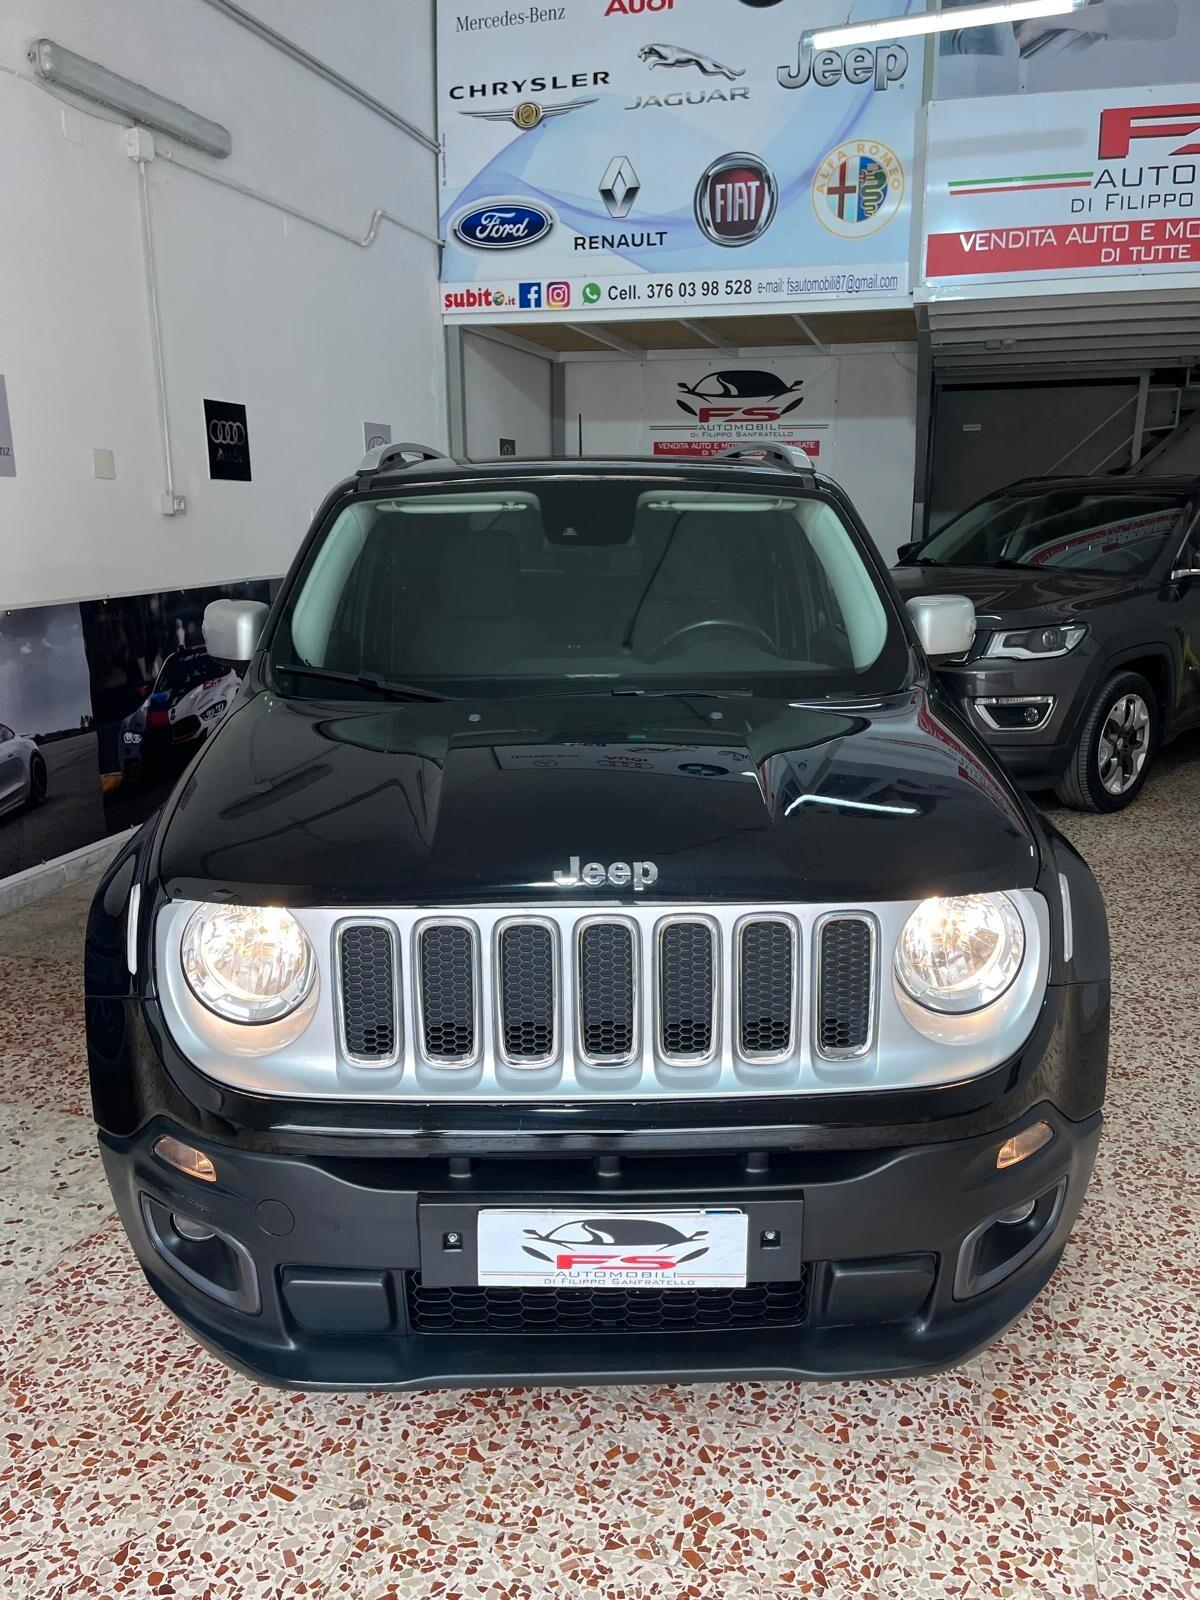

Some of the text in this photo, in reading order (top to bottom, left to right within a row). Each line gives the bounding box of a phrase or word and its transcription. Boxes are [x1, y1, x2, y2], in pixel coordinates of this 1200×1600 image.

[456, 7, 566, 32] Mercedes-Benz
[777, 40, 909, 91] Jeep
[449, 71, 610, 100] CHRYSLER
[624, 87, 751, 110] JAGUAR
[815, 143, 901, 194] ALFA ROMEO
[1094, 164, 1196, 189] AUTO
[714, 180, 760, 224] FIAT
[1071, 192, 1193, 213] DI FILIPPO
[475, 211, 529, 239] Ford
[960, 228, 1057, 252] VENDITA
[1065, 224, 1129, 245] AUTO
[1141, 222, 1155, 241] E
[574, 231, 668, 250] RENAULT
[1101, 244, 1191, 263] DI TUTTE
[608, 274, 898, 301] Cell. 376 03 98 528 e-mail: fsautomobili87@gmail.com
[699, 407, 781, 423] FS
[658, 442, 689, 450] VENDITA
[553, 855, 659, 890] Jeep
[556, 1254, 677, 1270] FS
[611, 1278, 695, 1286] SANFRATELLO
